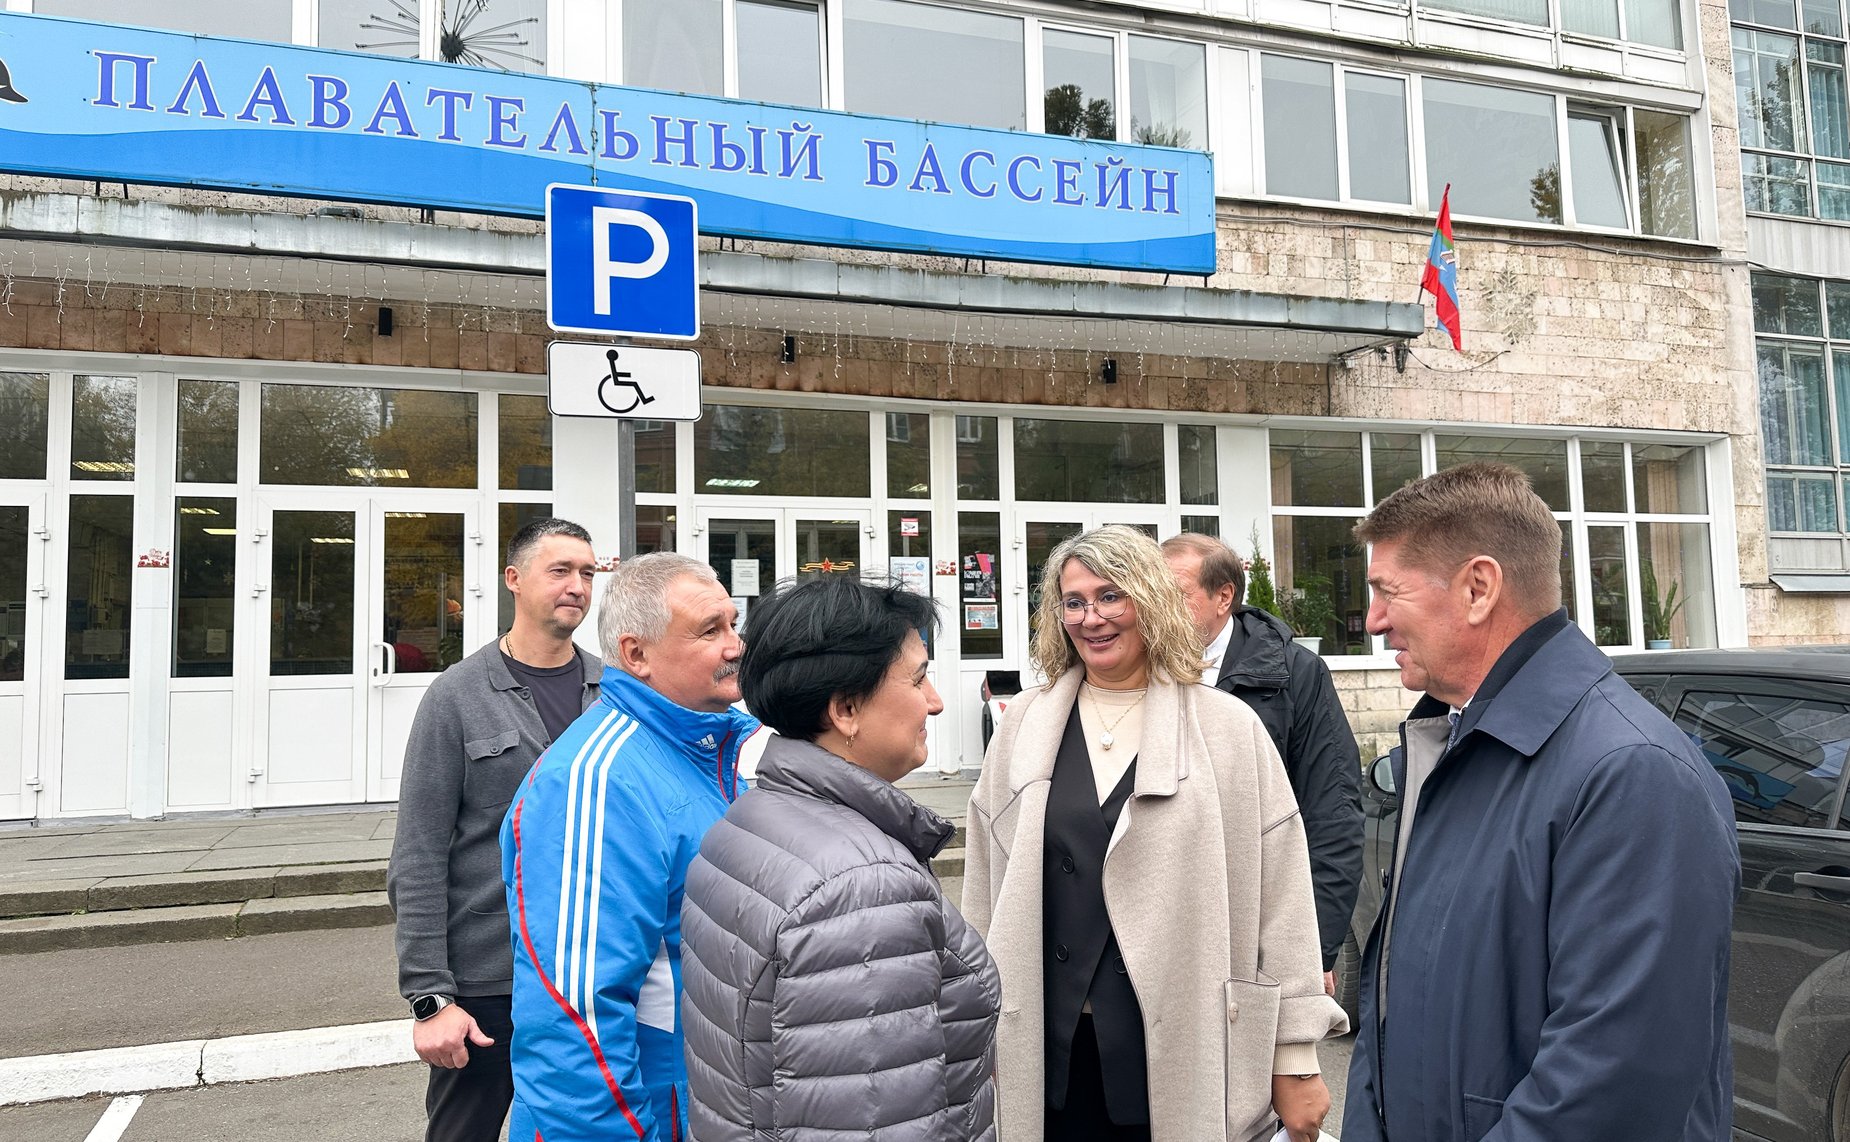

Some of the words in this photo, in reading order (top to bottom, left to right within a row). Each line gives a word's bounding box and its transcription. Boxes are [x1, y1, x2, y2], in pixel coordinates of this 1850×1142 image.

[92, 50, 824, 182] ПЛАВАТЕЛЬНЫЙ
[864, 139, 1181, 215] БАССЕЙН
[592, 206, 670, 316] P
